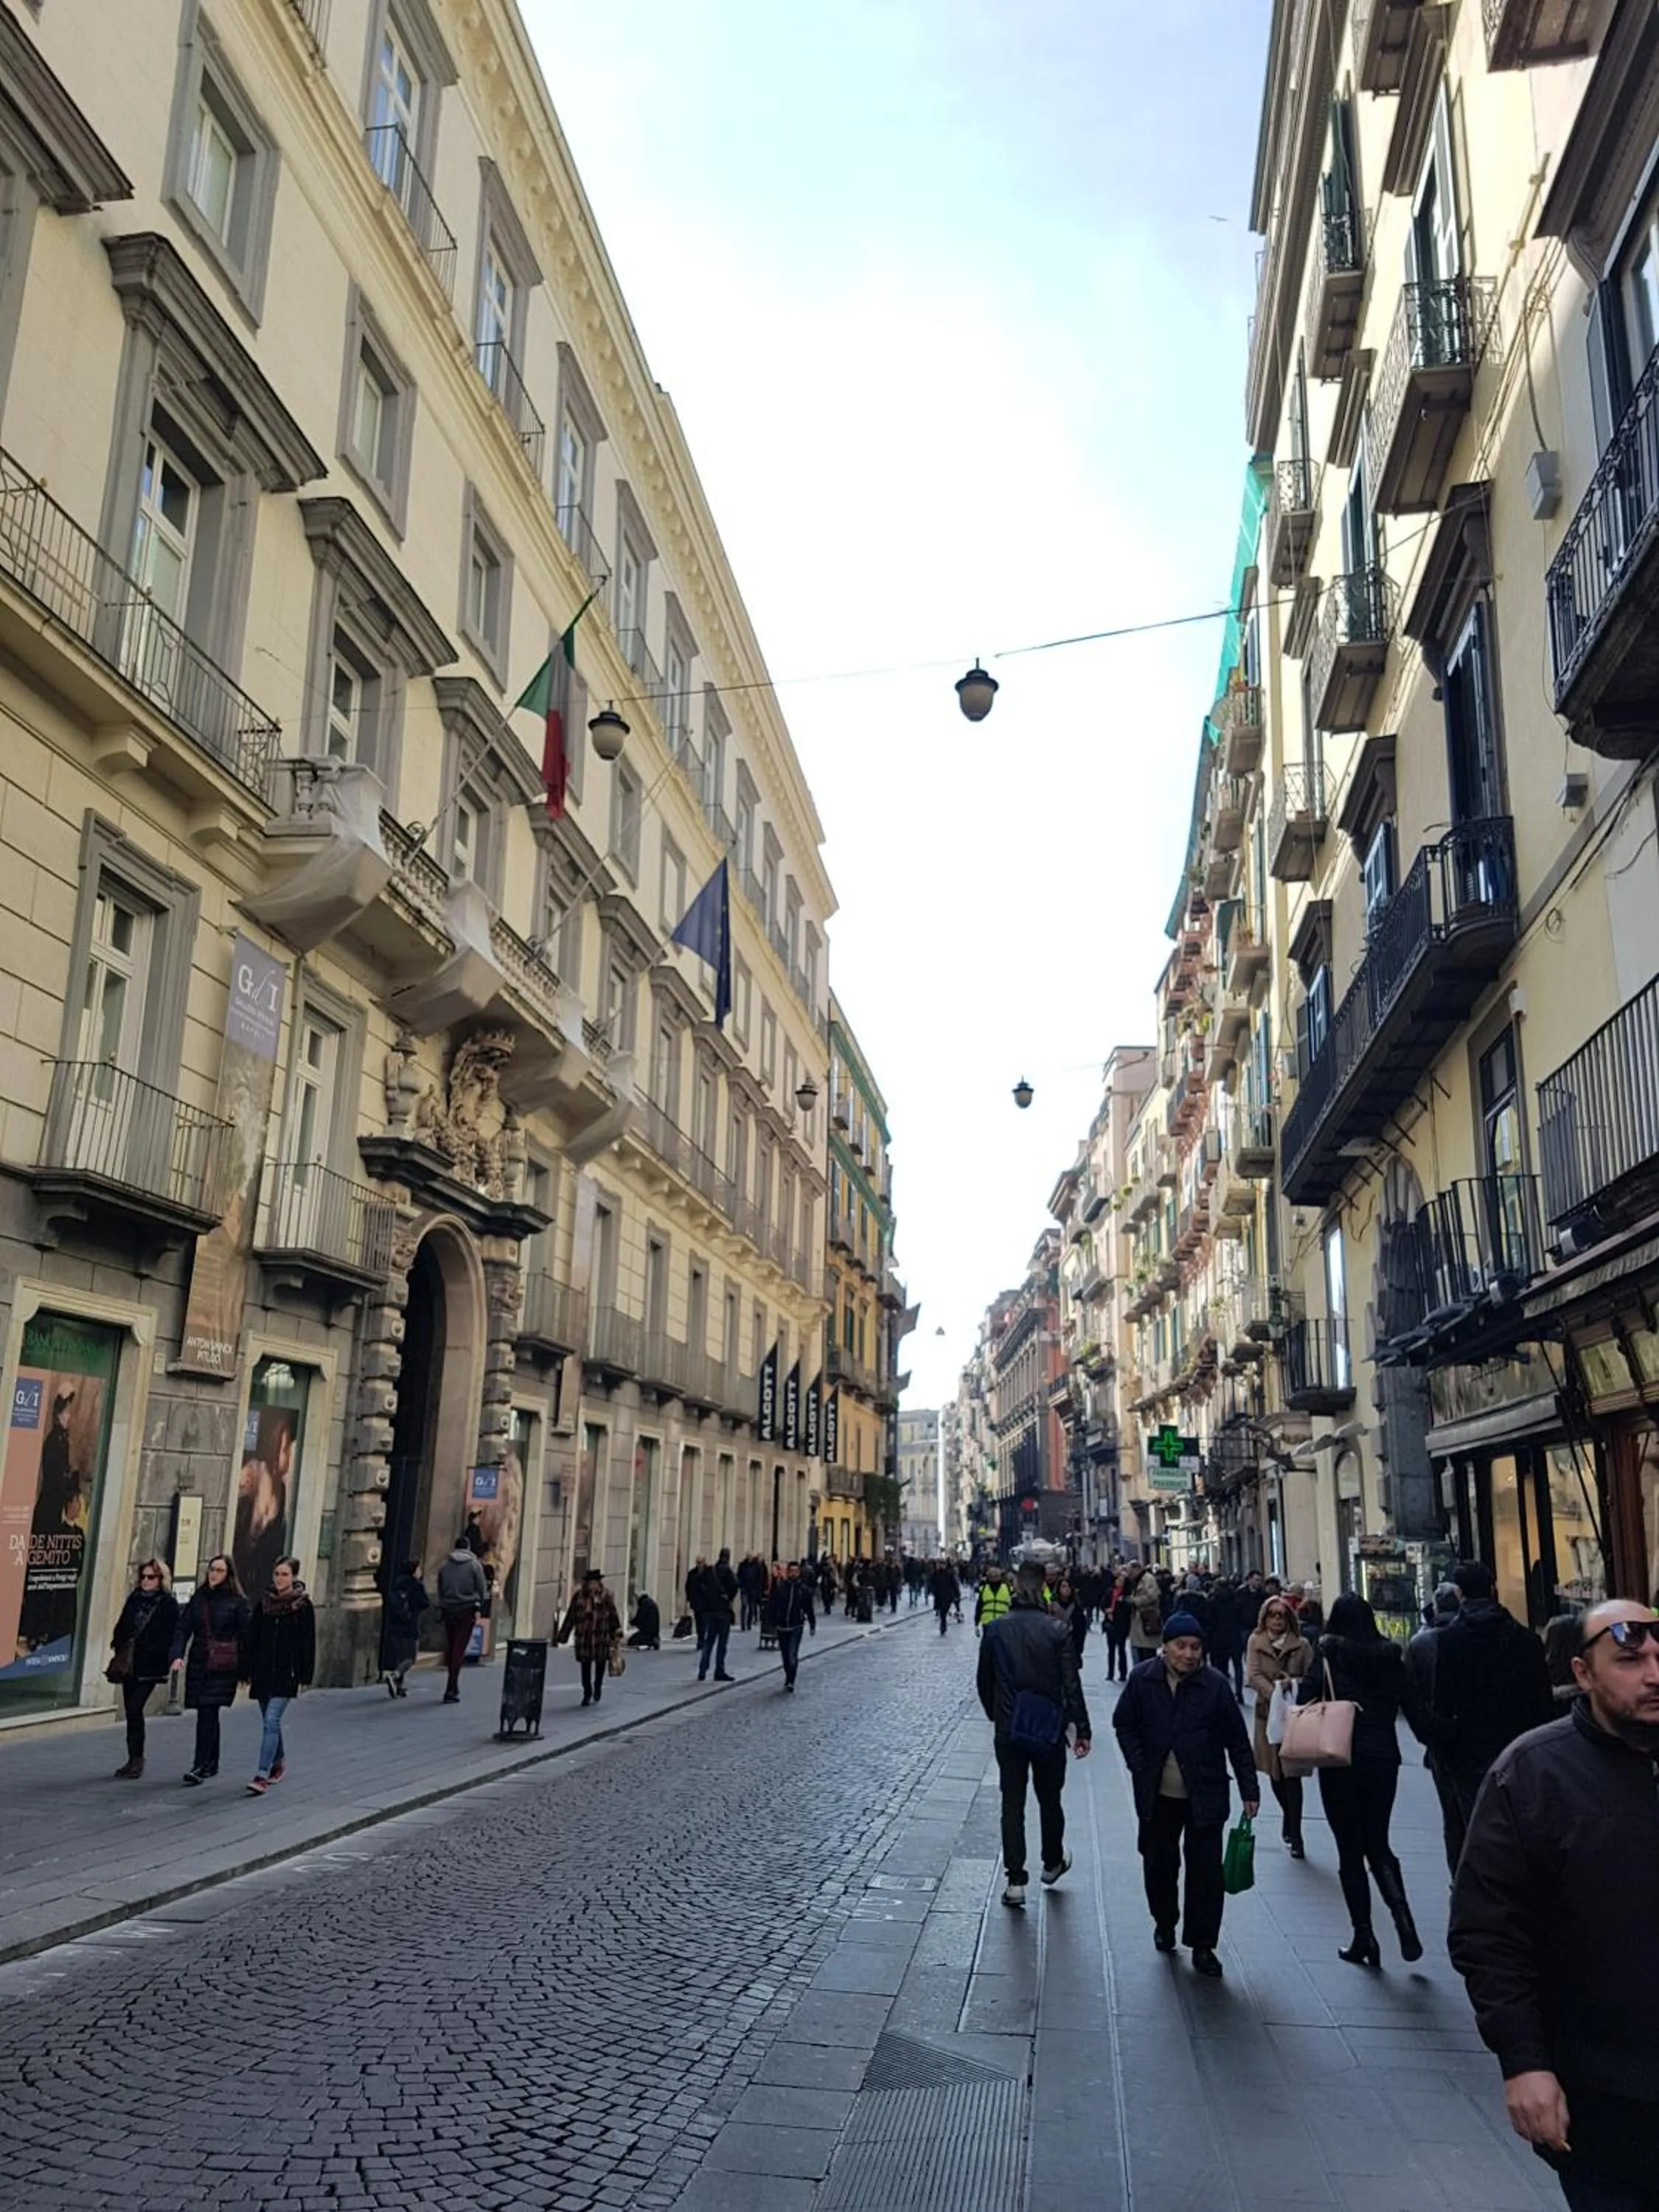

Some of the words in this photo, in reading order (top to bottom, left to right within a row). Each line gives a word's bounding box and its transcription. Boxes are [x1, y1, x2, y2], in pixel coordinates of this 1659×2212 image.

[762, 1364, 773, 1440] ALCOTT
[787, 1380, 797, 1449] ALCOTT
[808, 1391, 817, 1455] ALCOTT
[826, 1402, 835, 1462] ALCOTT
[10, 1534, 25, 1550] DA
[29, 1534, 45, 1549] DE
[46, 1534, 83, 1549] NITTIS
[15, 1551, 24, 1565] A
[29, 1549, 71, 1565] GEMITO
